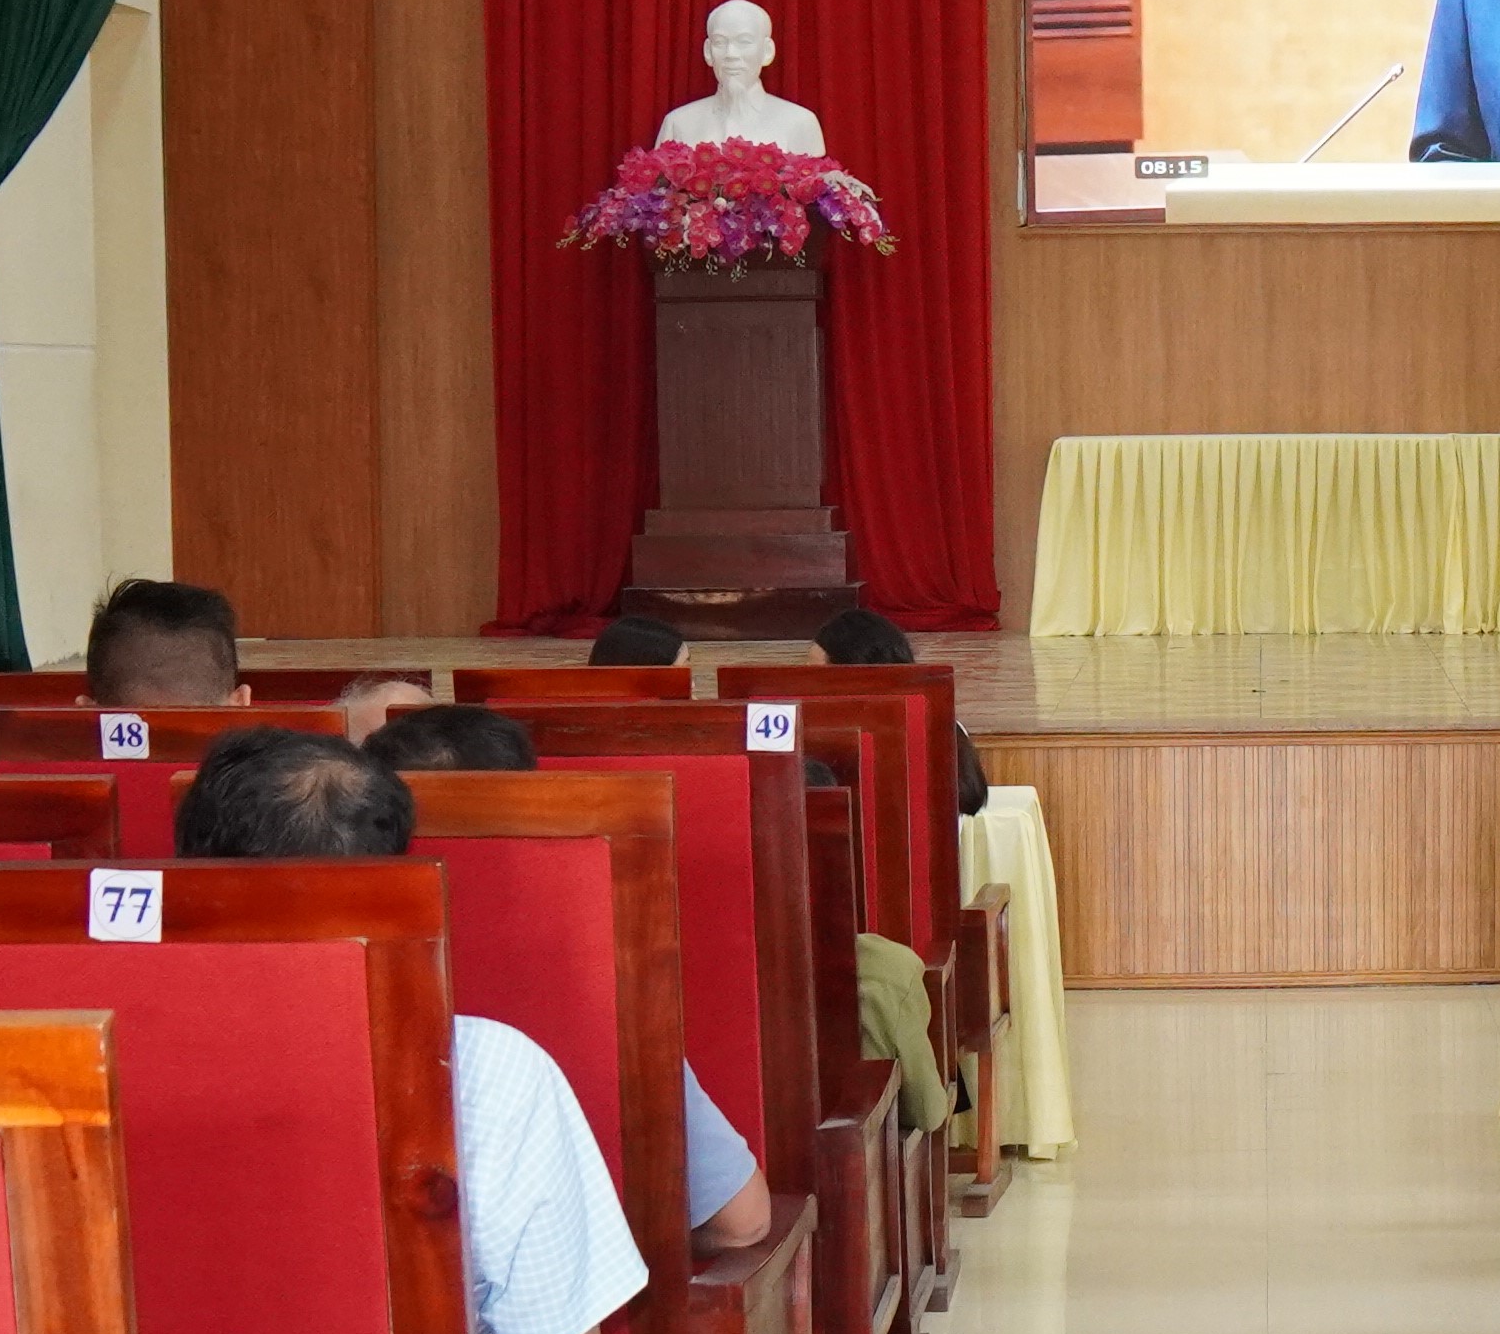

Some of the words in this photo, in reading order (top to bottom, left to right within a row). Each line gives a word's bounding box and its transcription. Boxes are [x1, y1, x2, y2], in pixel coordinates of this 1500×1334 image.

[1140, 159, 1203, 176] 08:15
[109, 722, 143, 747] 48
[755, 714, 789, 739] 49
[102, 886, 153, 924] 77
